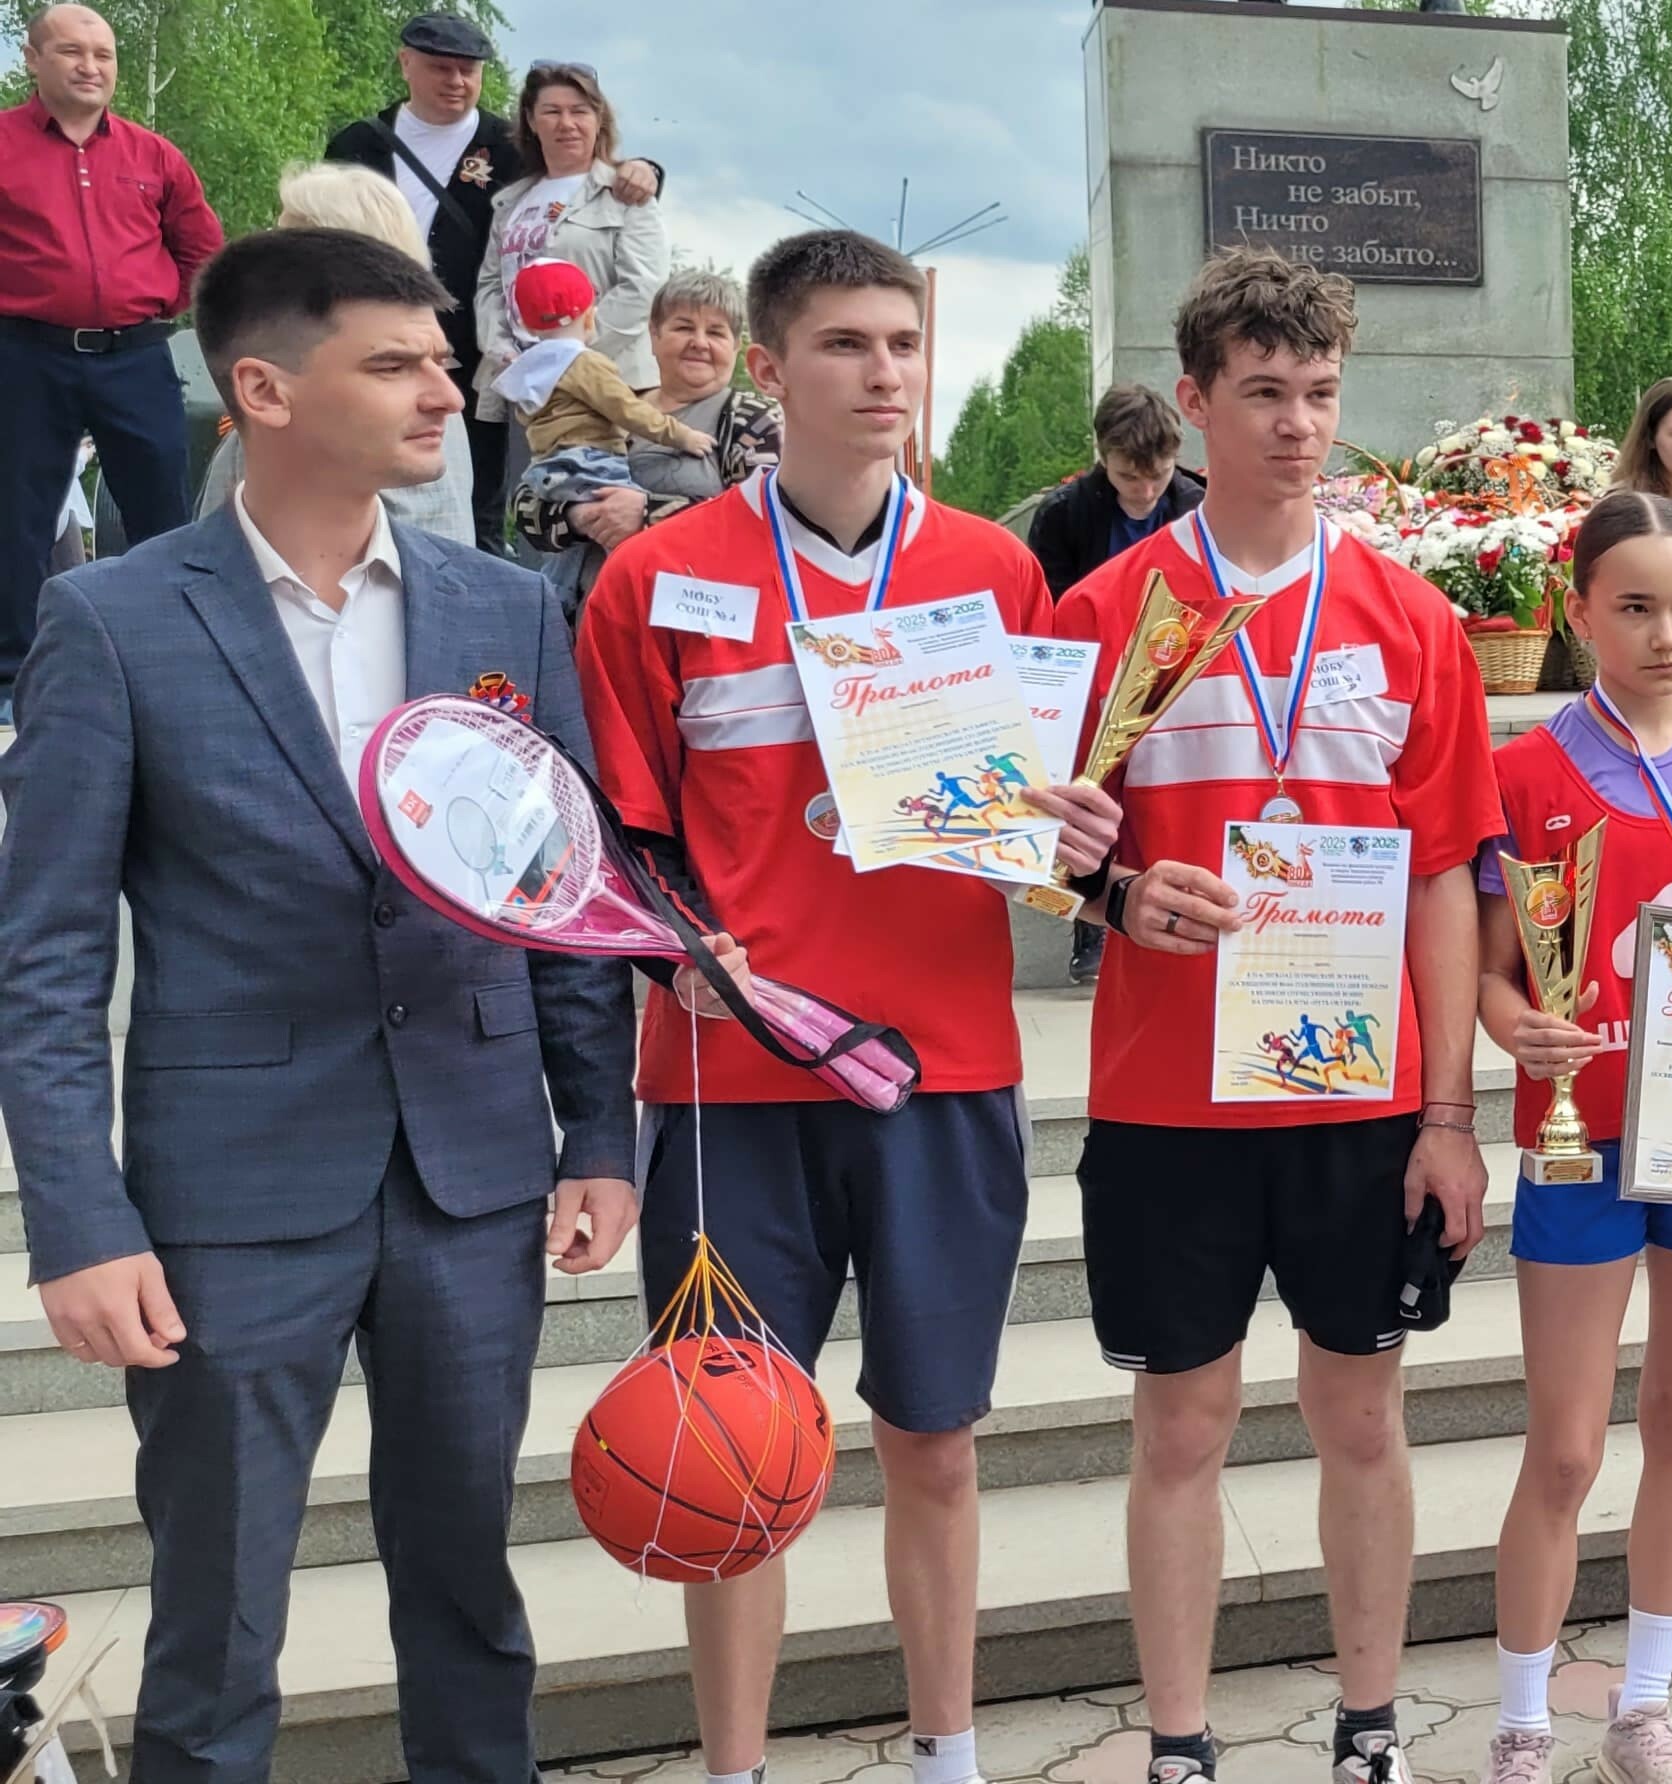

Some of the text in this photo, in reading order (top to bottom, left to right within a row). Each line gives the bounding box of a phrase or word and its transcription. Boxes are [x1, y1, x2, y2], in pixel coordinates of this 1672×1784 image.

[1231, 145, 1327, 173] Никто
[1287, 181, 1422, 210] не забыт,
[1233, 205, 1329, 232] Ничто
[1290, 240, 1458, 267] не забыто...
[896, 613, 928, 628] 2025
[953, 600, 985, 615] 2025
[831, 663, 993, 717] Грамота
[1320, 836, 1400, 850] 2025 2025
[1239, 890, 1386, 935] Грамота
